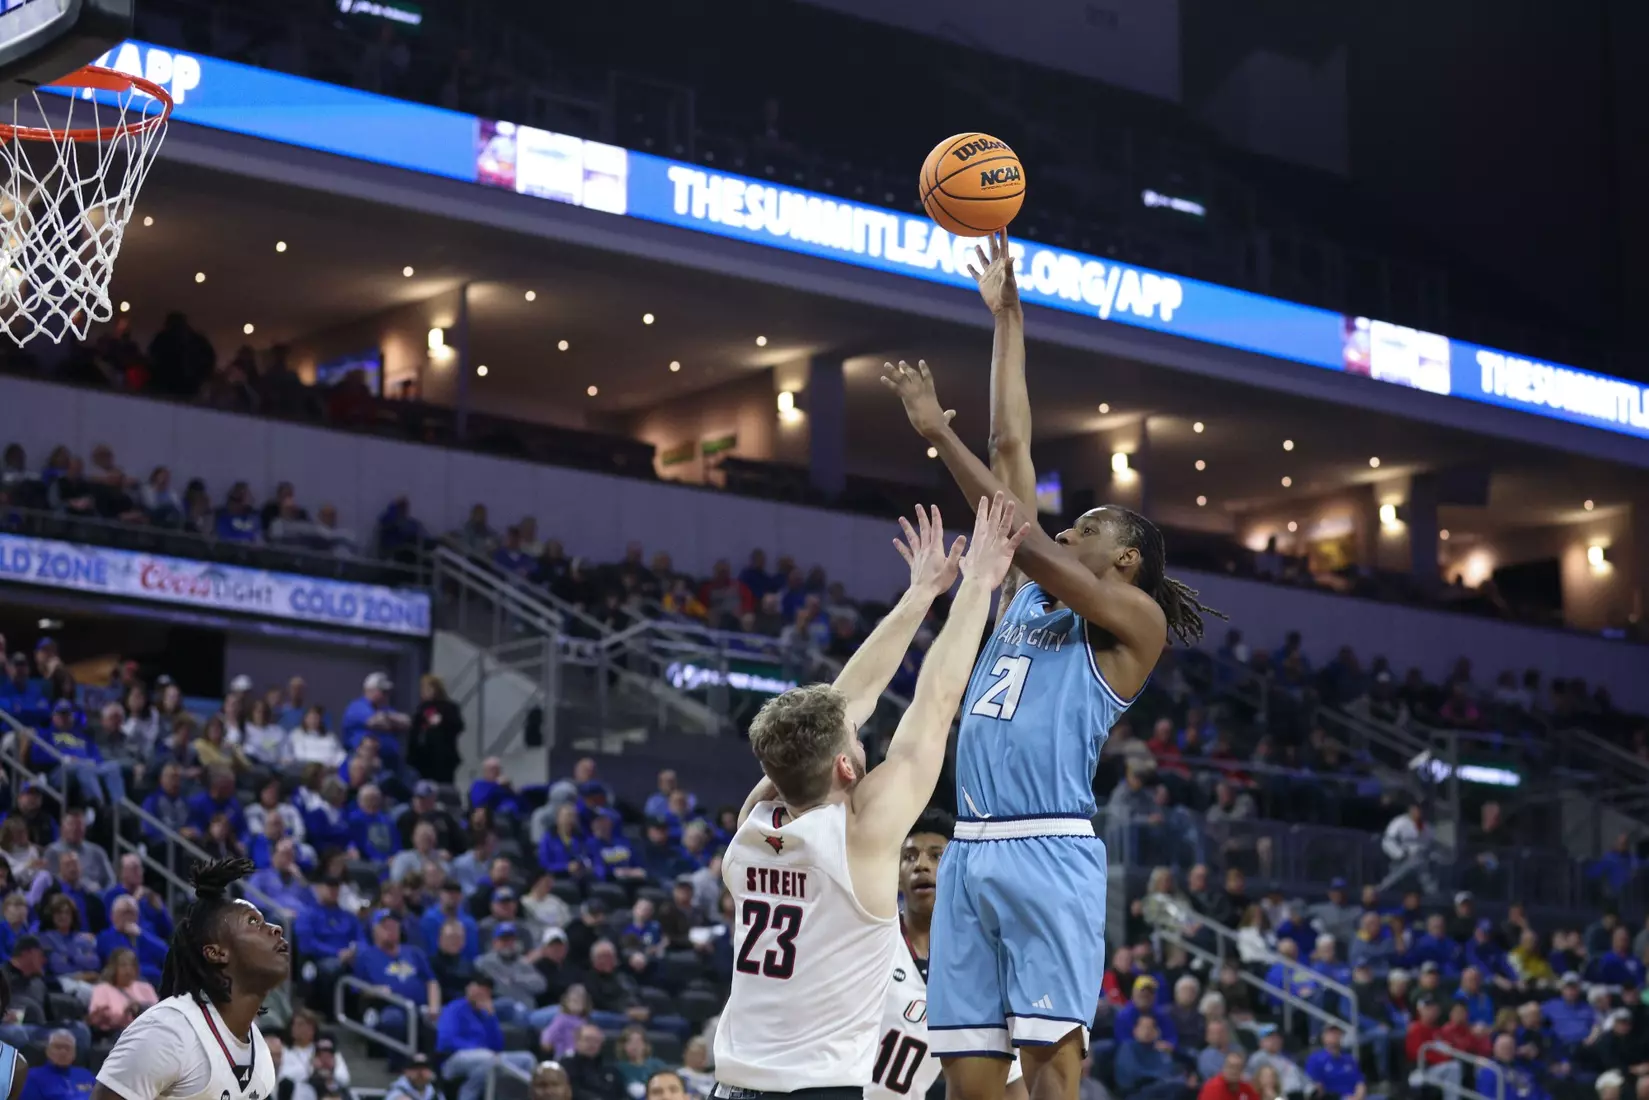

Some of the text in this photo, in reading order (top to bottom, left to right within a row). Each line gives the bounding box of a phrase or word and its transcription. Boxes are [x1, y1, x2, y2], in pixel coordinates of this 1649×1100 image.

[980, 166, 1020, 186] NCAA
[668, 166, 1183, 322] THESUMMITLEAGE.ORG/APP
[37, 551, 109, 586] ZONE
[140, 561, 211, 599] Coors
[287, 585, 427, 630] COLD ZONE
[1026, 627, 1068, 653] CITY
[970, 654, 1034, 722] 21
[746, 866, 808, 899] STREIT
[736, 898, 804, 981] 23
[872, 1028, 928, 1096] 10
